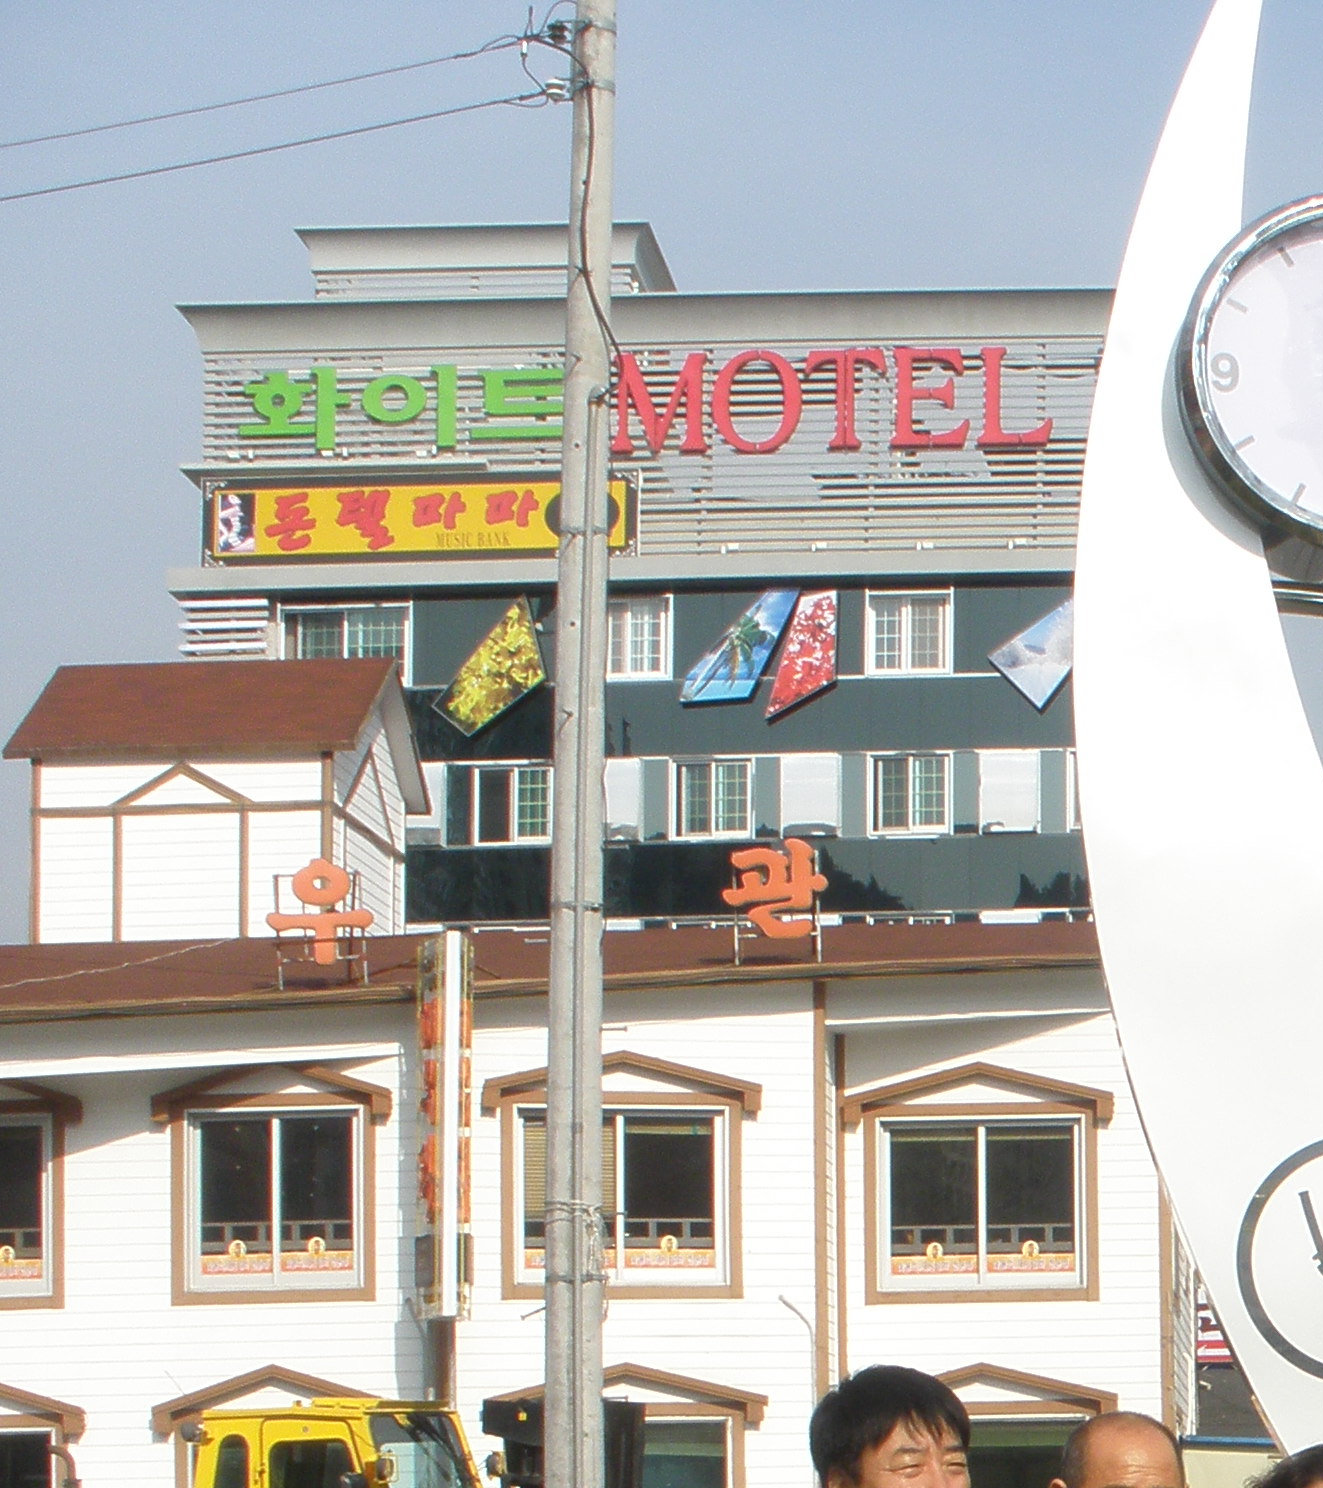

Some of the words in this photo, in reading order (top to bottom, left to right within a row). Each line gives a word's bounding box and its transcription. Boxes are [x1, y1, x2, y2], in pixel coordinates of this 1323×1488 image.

[1210, 353, 1240, 393] 9
[237, 365, 564, 452] 화이트
[611, 346, 1053, 455] MOTEL
[435, 531, 473, 548] MUSIC
[476, 530, 512, 547] BANK
